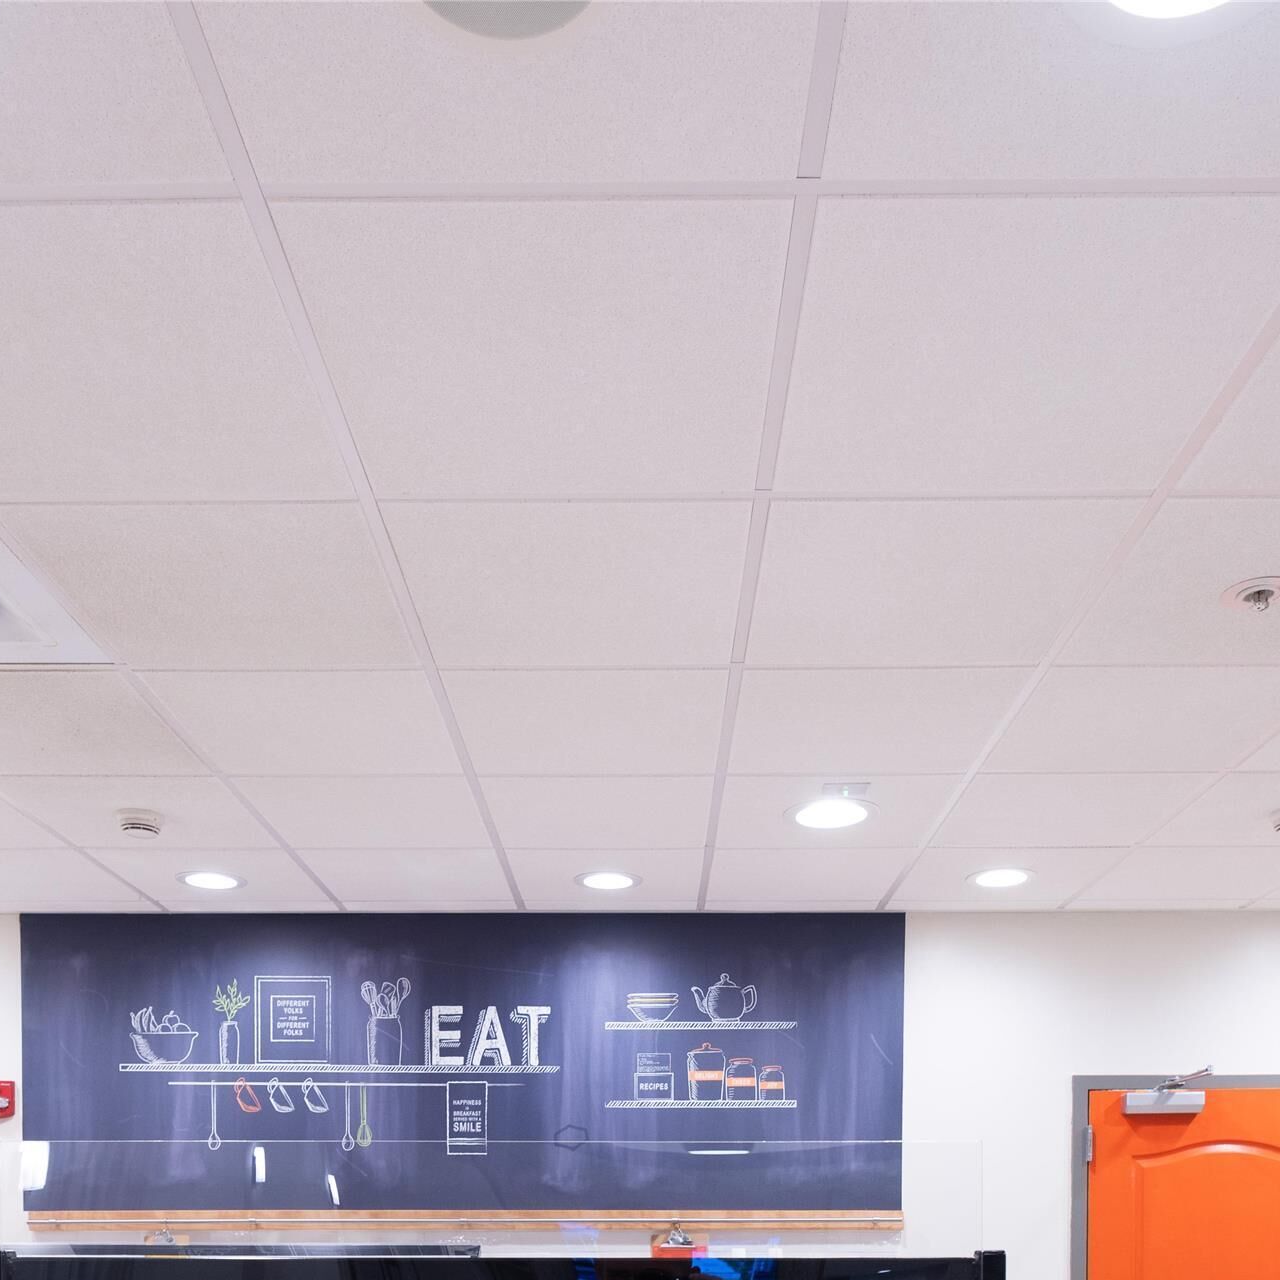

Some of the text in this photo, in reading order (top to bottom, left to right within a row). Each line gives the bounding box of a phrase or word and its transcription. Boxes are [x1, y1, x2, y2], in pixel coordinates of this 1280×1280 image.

[424, 1005, 552, 1066] EAT
[640, 1083, 669, 1091] RECIPES
[453, 1122, 482, 1132] SMILE
